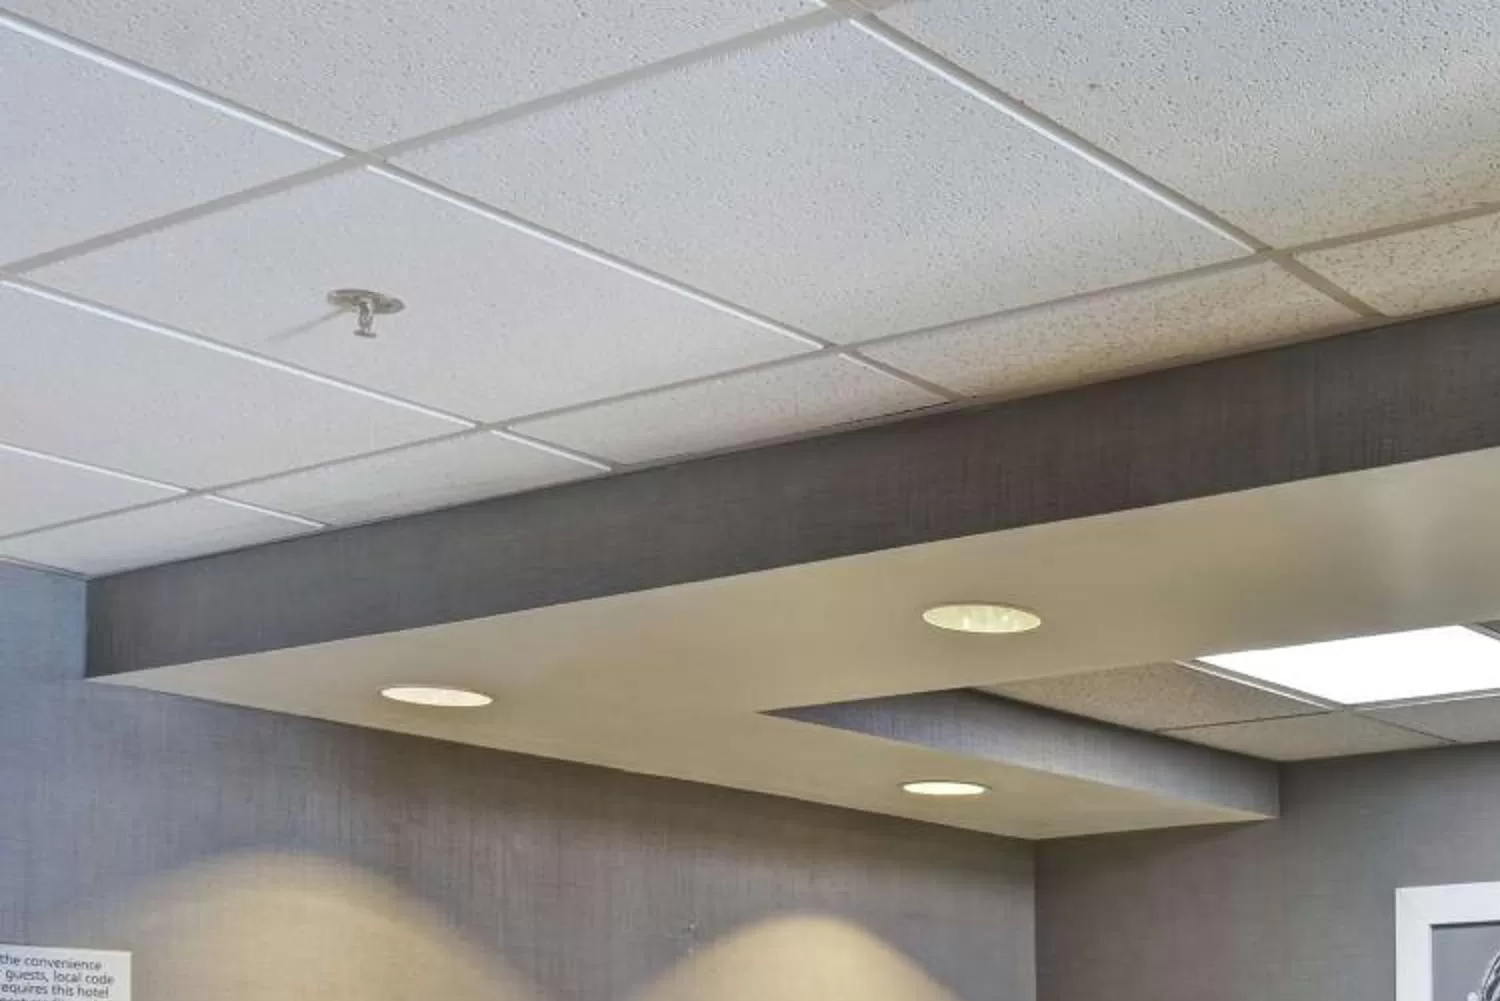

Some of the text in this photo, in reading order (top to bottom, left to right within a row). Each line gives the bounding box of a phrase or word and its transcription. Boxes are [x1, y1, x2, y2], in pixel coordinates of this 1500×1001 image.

[24, 957, 103, 970] convenience
[53, 969, 81, 982] local
[84, 974, 114, 985] code
[52, 984, 74, 996] this
[77, 985, 109, 998] hotel
